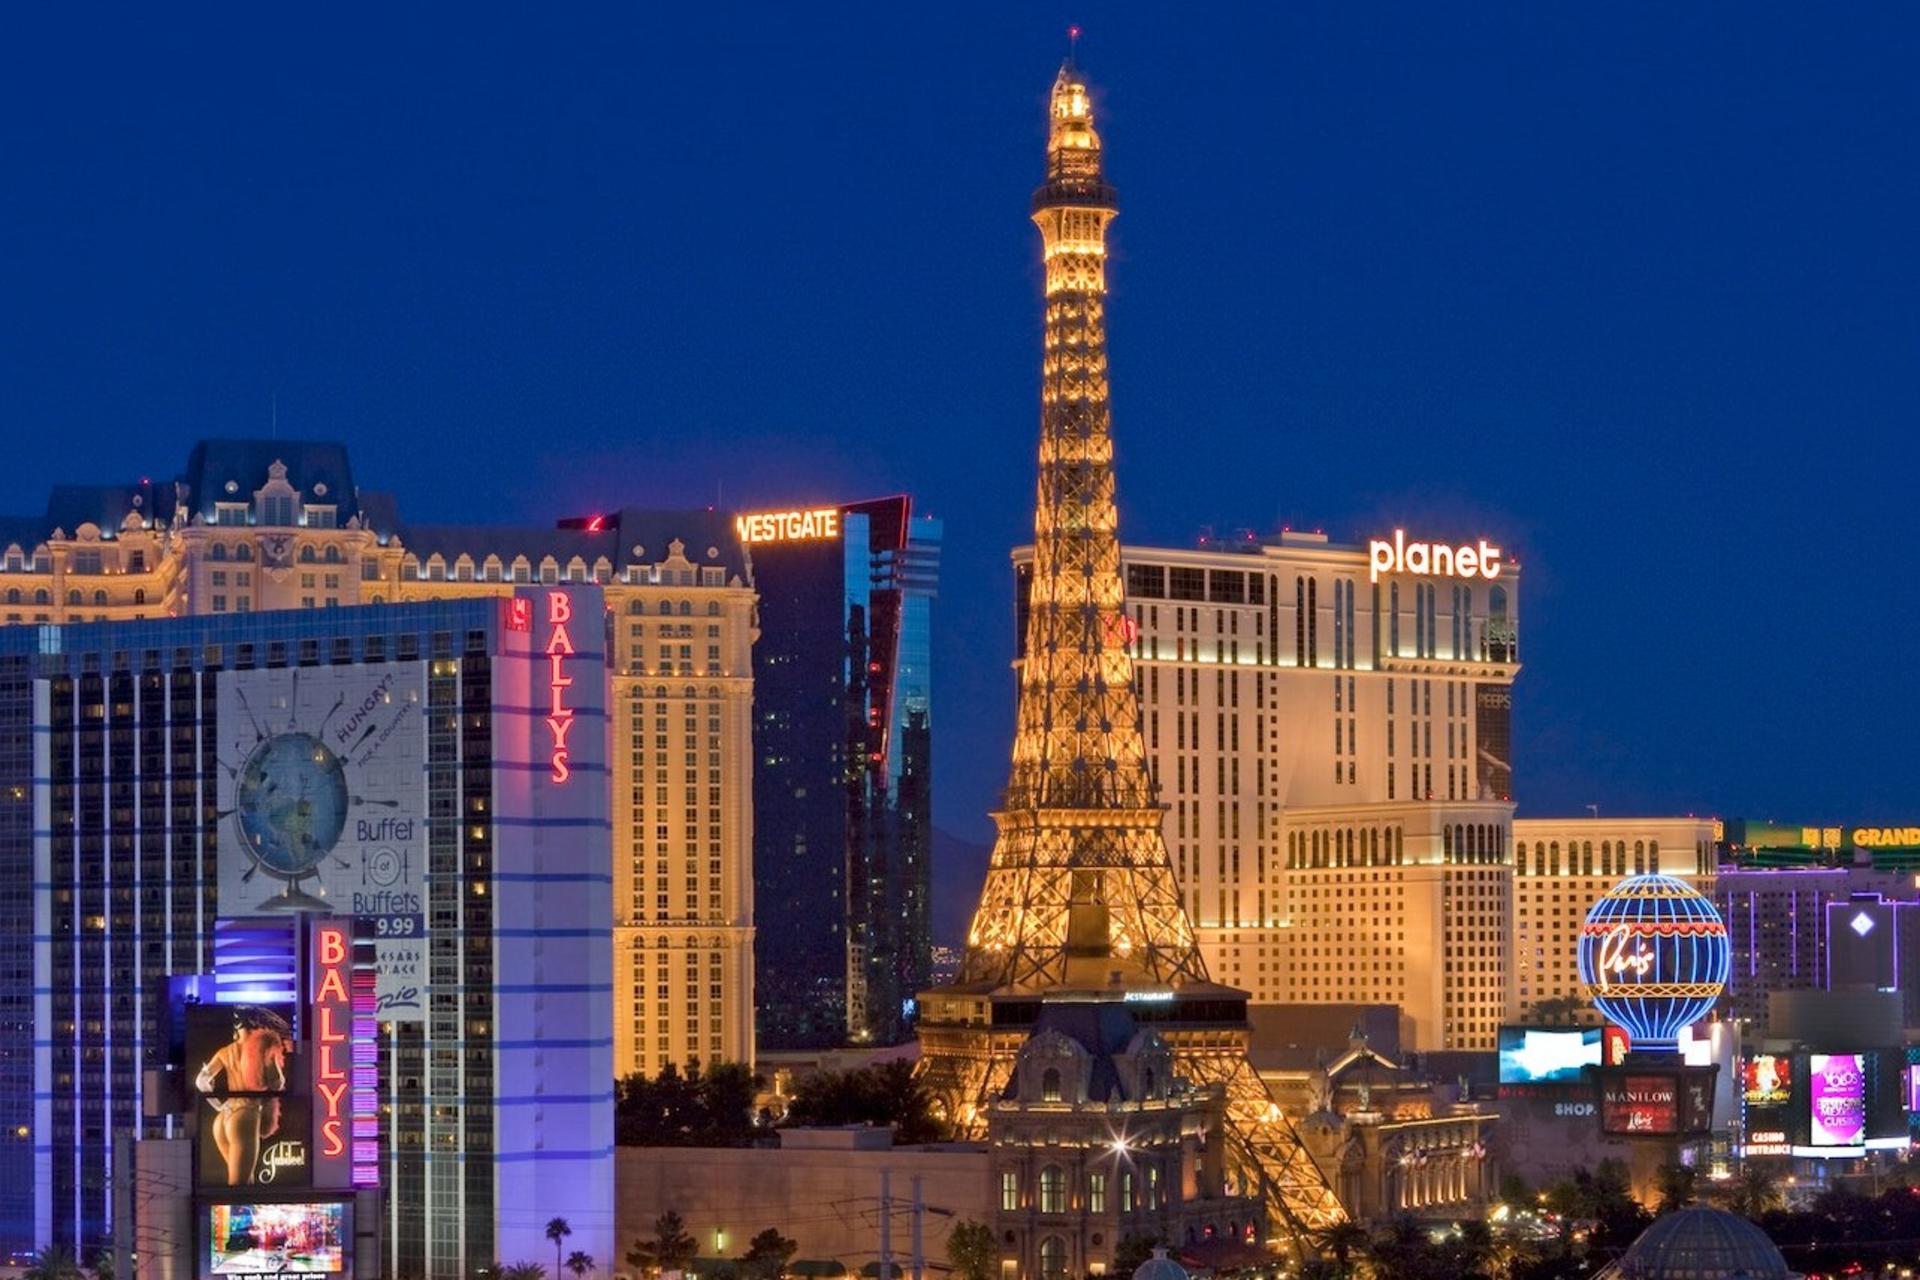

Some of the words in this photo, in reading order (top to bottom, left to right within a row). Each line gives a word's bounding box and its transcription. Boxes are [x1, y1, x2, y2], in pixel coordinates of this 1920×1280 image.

[1370, 529, 1501, 583] planet
[546, 591, 574, 783] BALLYS
[337, 673, 394, 743] HUNGRY?
[357, 817, 414, 841] Buffet
[353, 890, 420, 913] Buffets
[1599, 923, 1655, 993] Paris
[376, 985, 420, 1013] Rio
[316, 930, 348, 1156] BALLYS
[1604, 1091, 1673, 1103] MANILOW
[1751, 1132, 1785, 1143] CASINO
